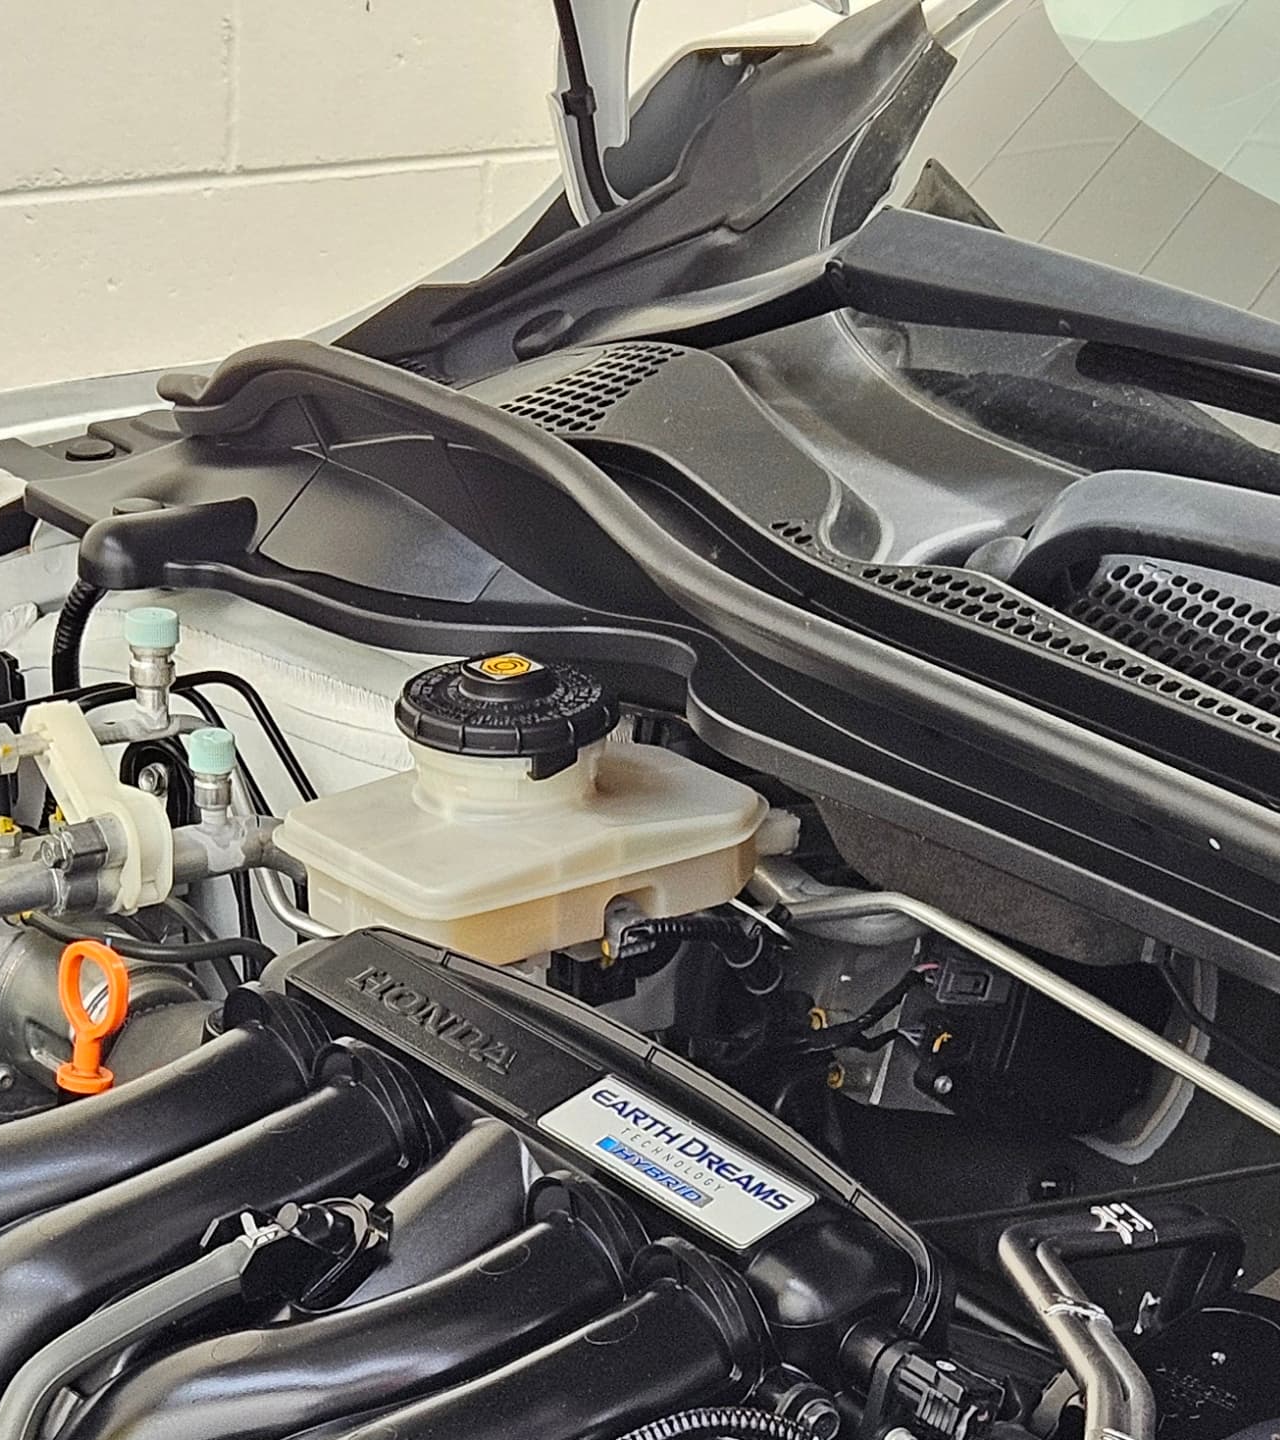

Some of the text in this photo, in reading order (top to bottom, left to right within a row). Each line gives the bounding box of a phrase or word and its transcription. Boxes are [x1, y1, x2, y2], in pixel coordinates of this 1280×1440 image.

[344, 966, 519, 1076] HONDA
[591, 1089, 796, 1211] EARTH DREAMS
[613, 1145, 704, 1203] HYBRID
[621, 1127, 725, 1192] TECHNOLOGY
